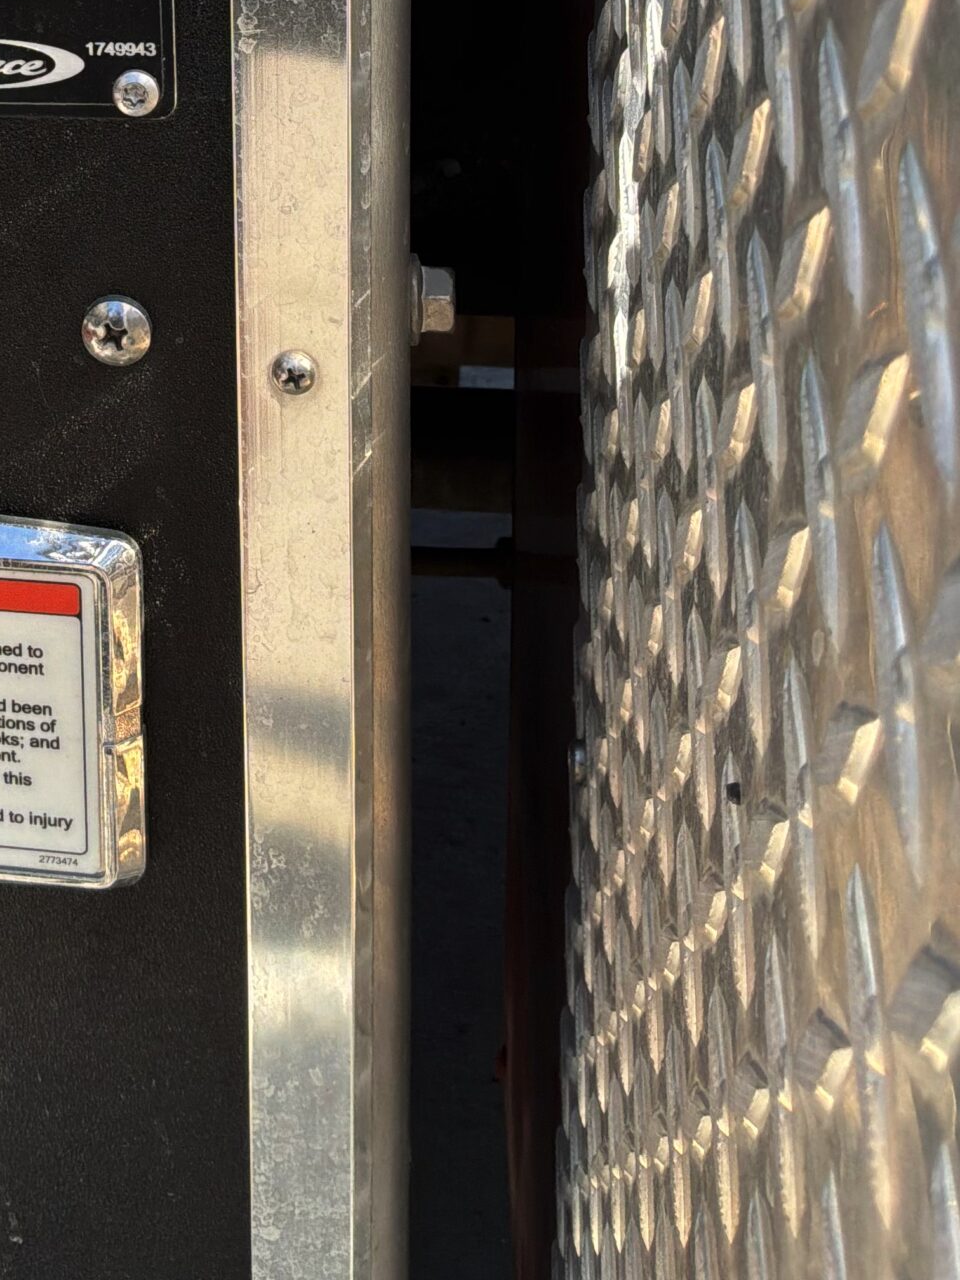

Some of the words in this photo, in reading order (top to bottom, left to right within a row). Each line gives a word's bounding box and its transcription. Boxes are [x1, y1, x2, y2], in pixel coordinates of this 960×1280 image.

[86, 42, 156, 56] 1749943
[26, 645, 43, 658] to
[10, 699, 52, 715] been
[39, 719, 56, 733] of
[28, 736, 60, 749] and
[2, 771, 32, 786] this
